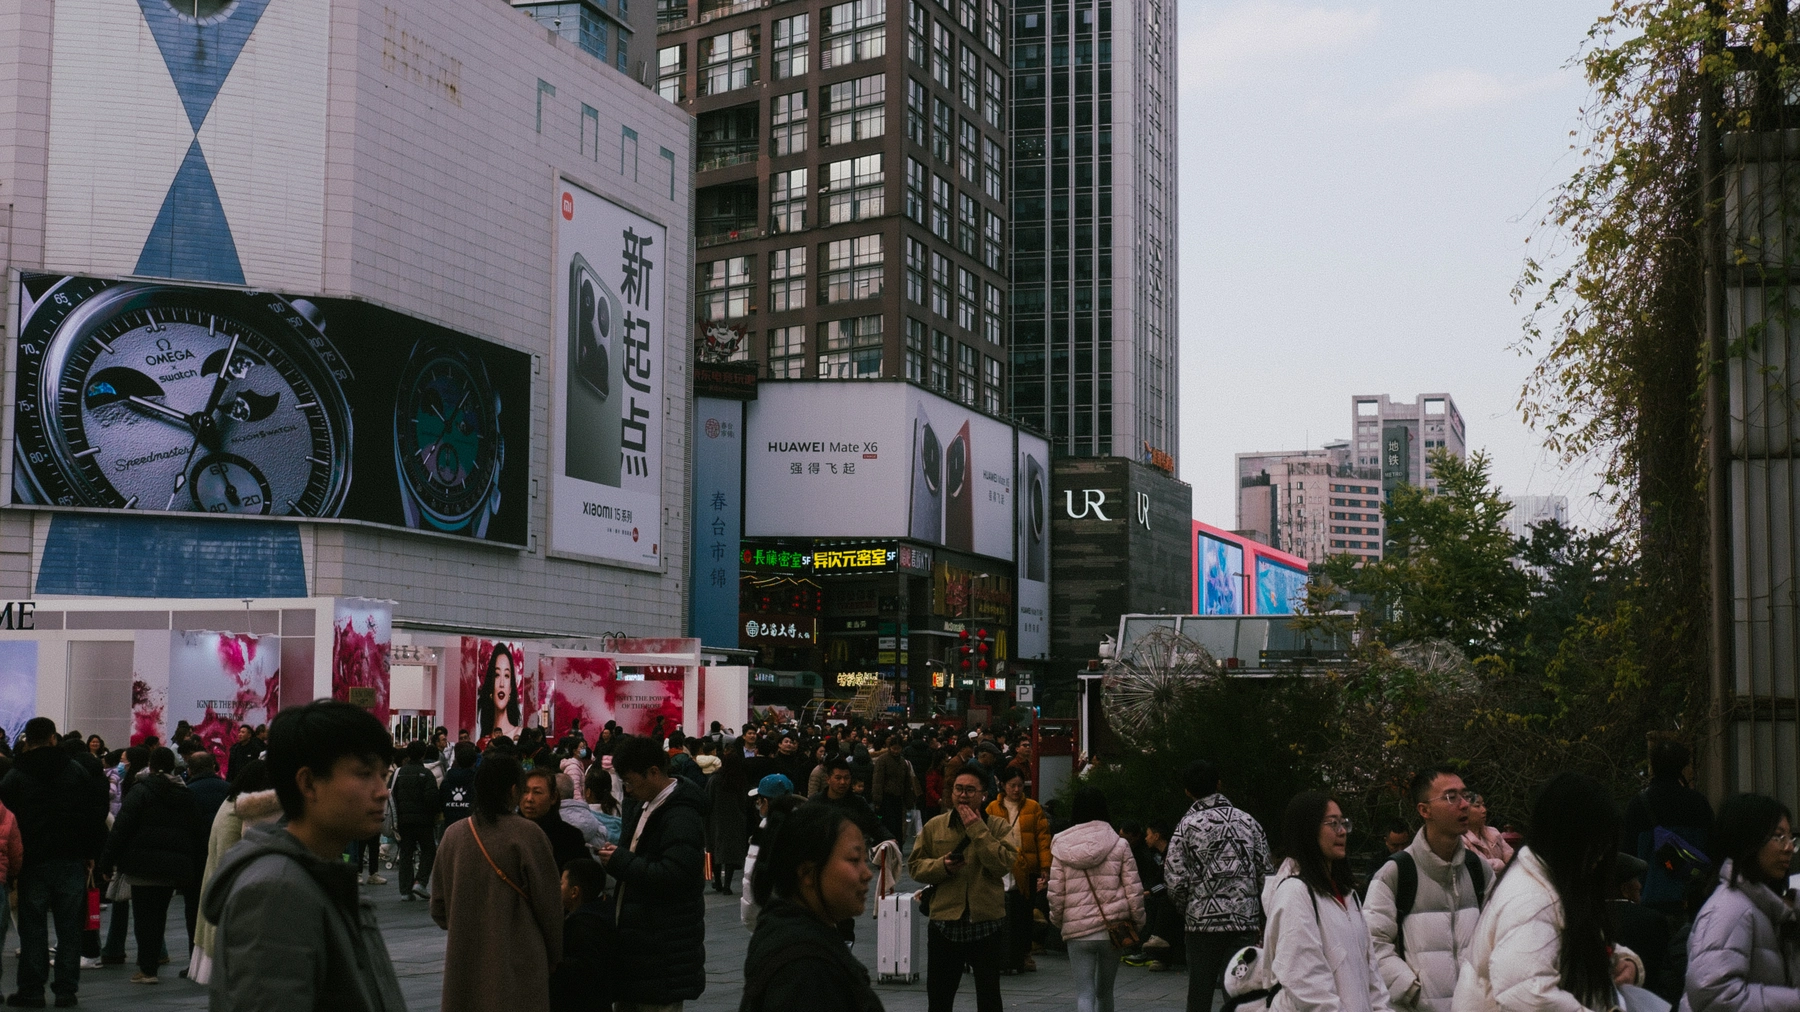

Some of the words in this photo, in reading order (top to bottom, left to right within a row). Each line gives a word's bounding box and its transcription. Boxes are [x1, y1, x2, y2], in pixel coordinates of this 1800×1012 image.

[53, 292, 69, 305] 65
[20, 343, 35, 355] 70
[620, 226, 653, 478] 新起点
[145, 349, 196, 366] OMEGA
[158, 369, 198, 384] swatch
[18, 400, 30, 412] 75
[768, 442, 826, 453] HUAWEI
[829, 442, 860, 453] Mate
[863, 442, 878, 453] X6
[1388, 440, 1400, 466] 地铁
[29, 451, 45, 464] 80
[114, 445, 192, 472] Speedmaster
[210, 464, 229, 476] 60
[790, 462, 856, 475] 强得飞起
[242, 494, 261, 507] 20
[1064, 489, 1112, 522] UR
[1136, 491, 1150, 530] UR
[710, 491, 728, 589] 春台市锦
[802, 555, 812, 566] 5F
[814, 548, 886, 570] 异次元密室
[886, 551, 896, 562] 5F
[1018, 687, 1029, 700] P
[219, 700, 232, 708] THE
